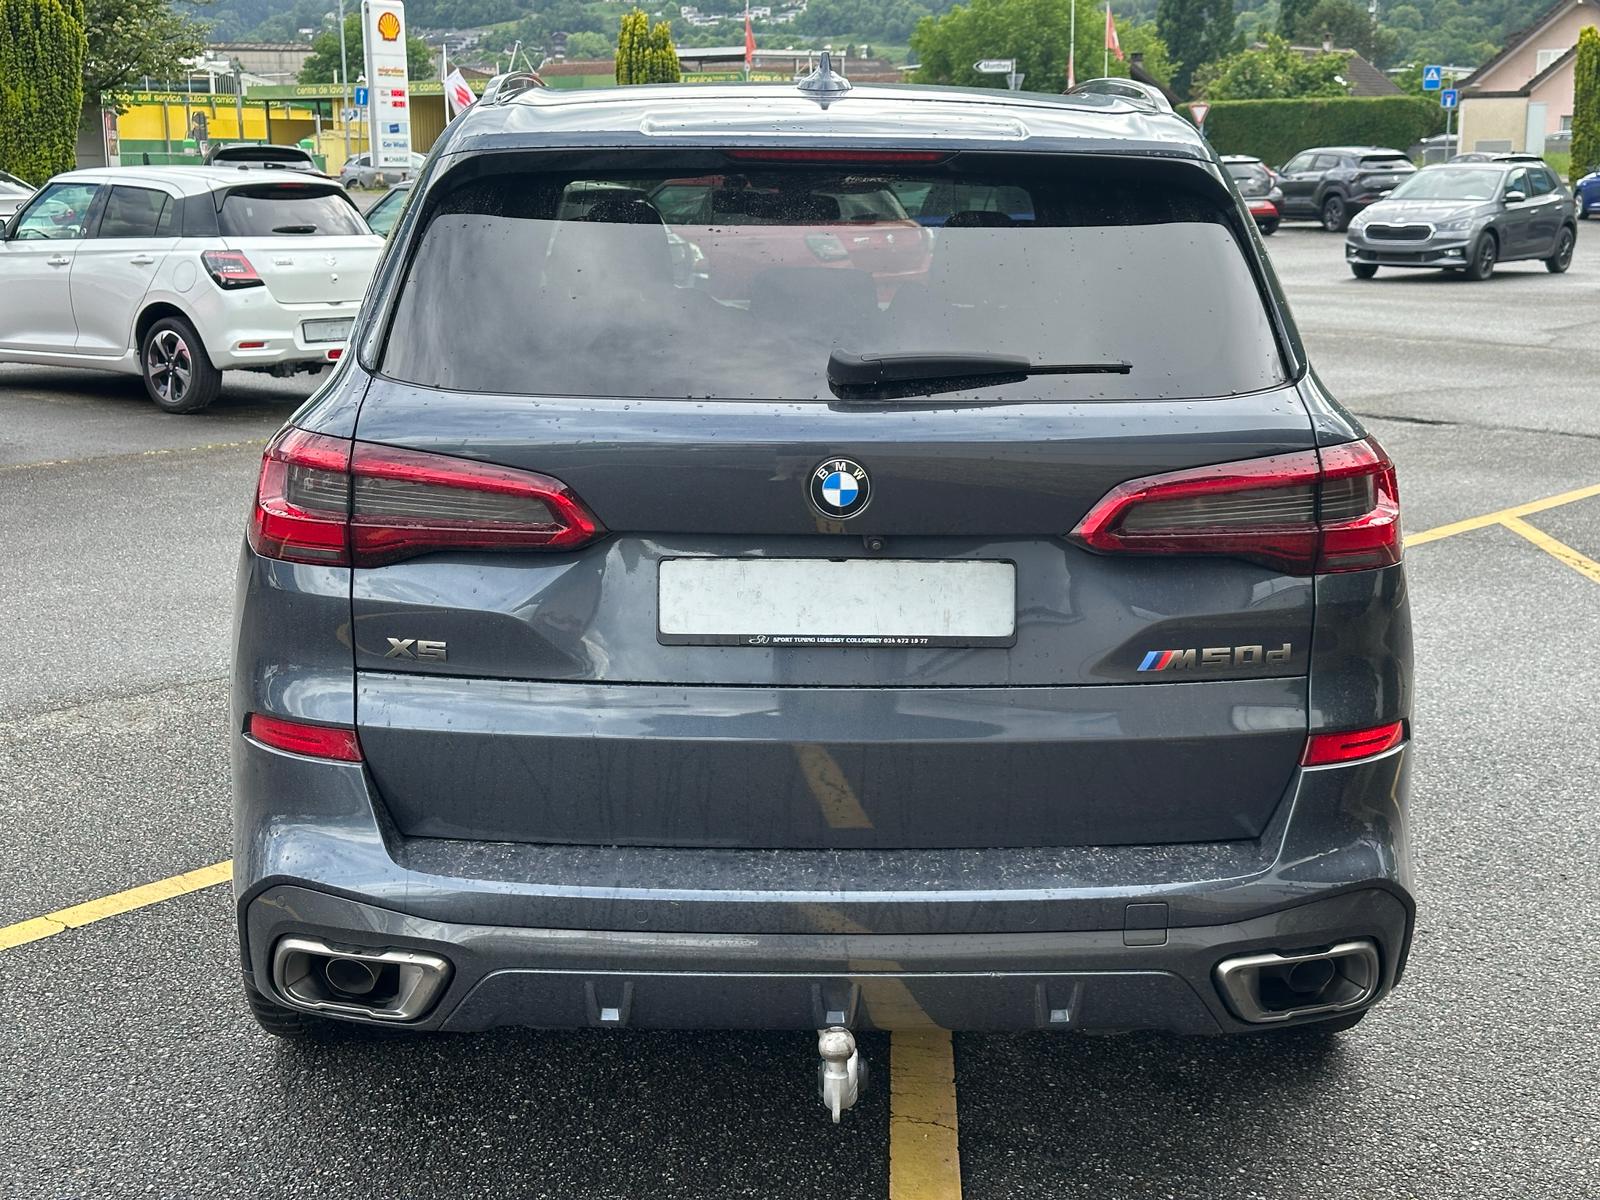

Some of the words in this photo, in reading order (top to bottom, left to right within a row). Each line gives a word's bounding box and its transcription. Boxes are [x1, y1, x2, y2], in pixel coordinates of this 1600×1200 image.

[297, 87, 316, 95] centre
[319, 86, 328, 94] de
[817, 462, 865, 480] BMW
[384, 637, 447, 662] X5
[1160, 643, 1292, 670] M50d
